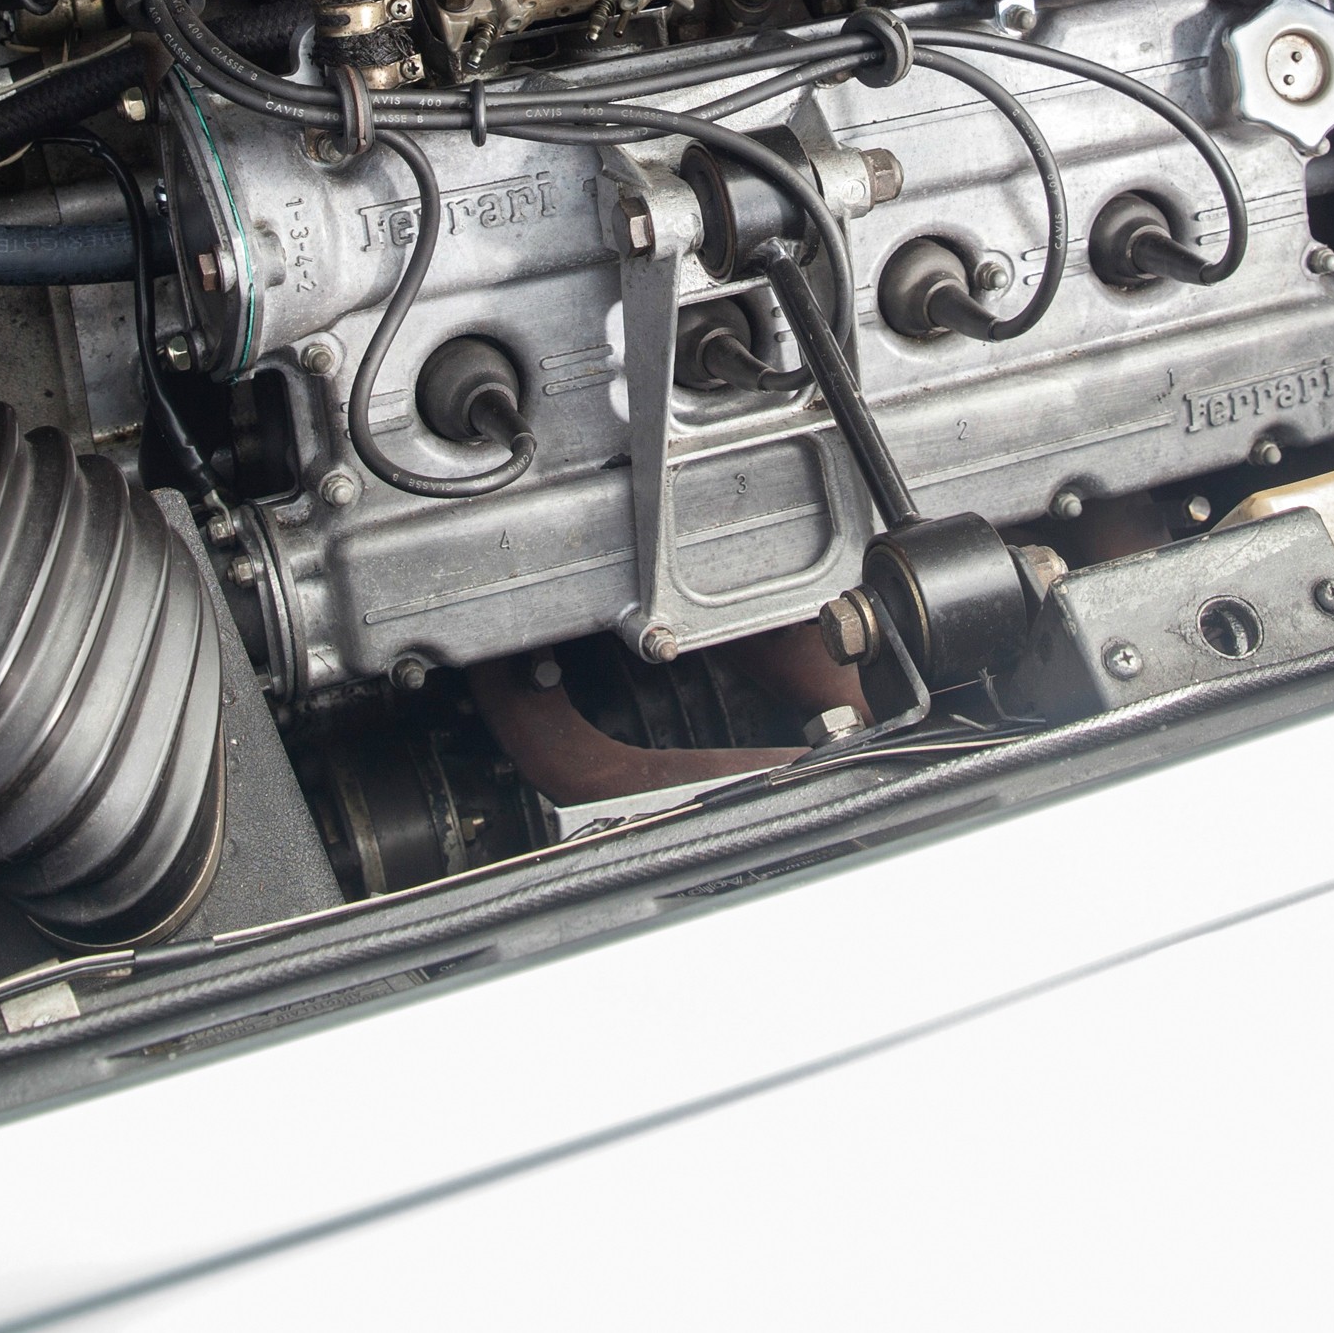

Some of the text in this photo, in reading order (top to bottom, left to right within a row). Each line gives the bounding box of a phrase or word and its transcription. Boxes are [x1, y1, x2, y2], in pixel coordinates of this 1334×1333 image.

[187, 23, 203, 40] 400
[210, 46, 245, 74] CLASSE
[251, 72, 258, 81] B
[863, 51, 877, 61] 00
[148, 6, 341, 121] 400 CLASSE B CAVIS 40
[372, 95, 442, 108] AVIS 400
[700, 101, 735, 120] CAVIS
[373, 113, 424, 124] LASSE B
[525, 108, 562, 118] CAVIS
[621, 109, 663, 122] CLASSE
[1047, 173, 1060, 195] 400
[358, 171, 558, 253] Ferari
[1054, 213, 1064, 250] CAVIS
[957, 418, 970, 440] 2
[507, 454, 530, 475] CAVIS
[408, 477, 454, 491] CLASSE
[736, 473, 749, 494] 3
[499, 530, 510, 550] 4
